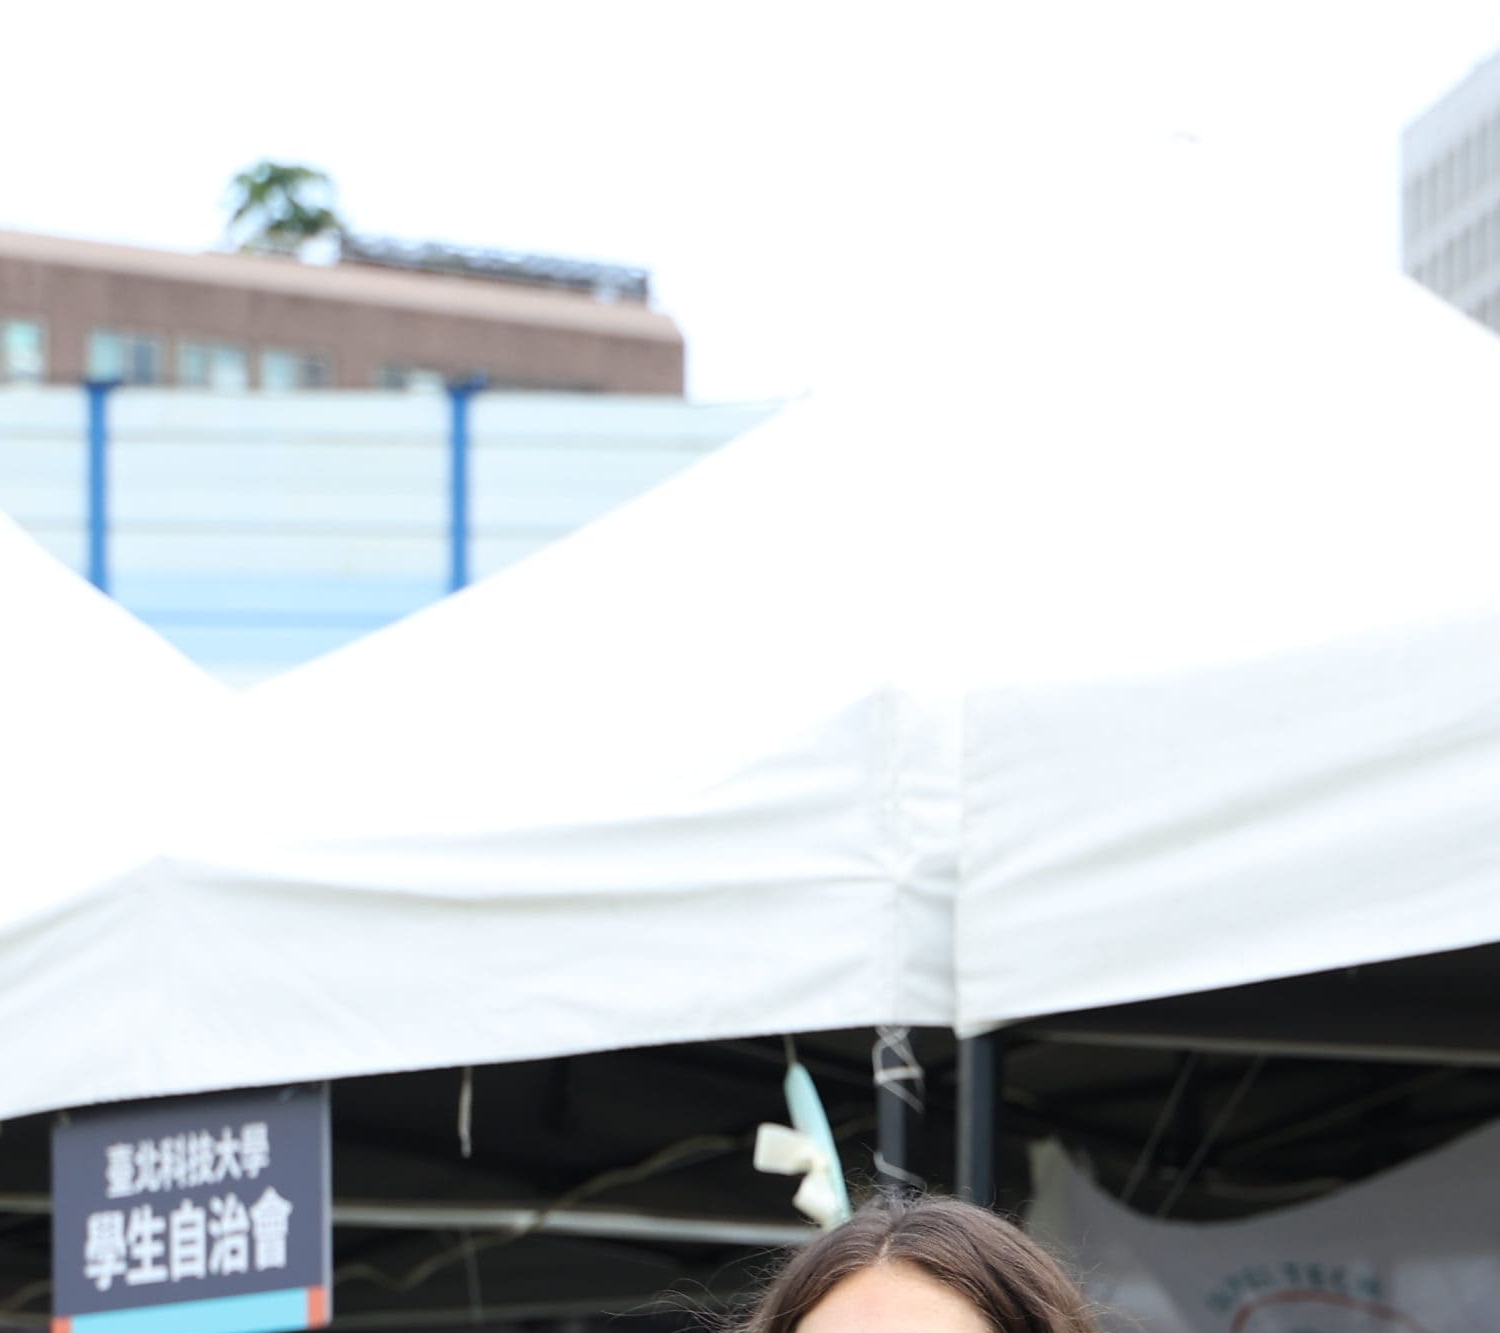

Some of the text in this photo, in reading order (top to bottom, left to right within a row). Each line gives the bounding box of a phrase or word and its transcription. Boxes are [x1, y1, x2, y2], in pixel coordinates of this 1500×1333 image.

[84, 1186, 293, 1291] 學生自治會
